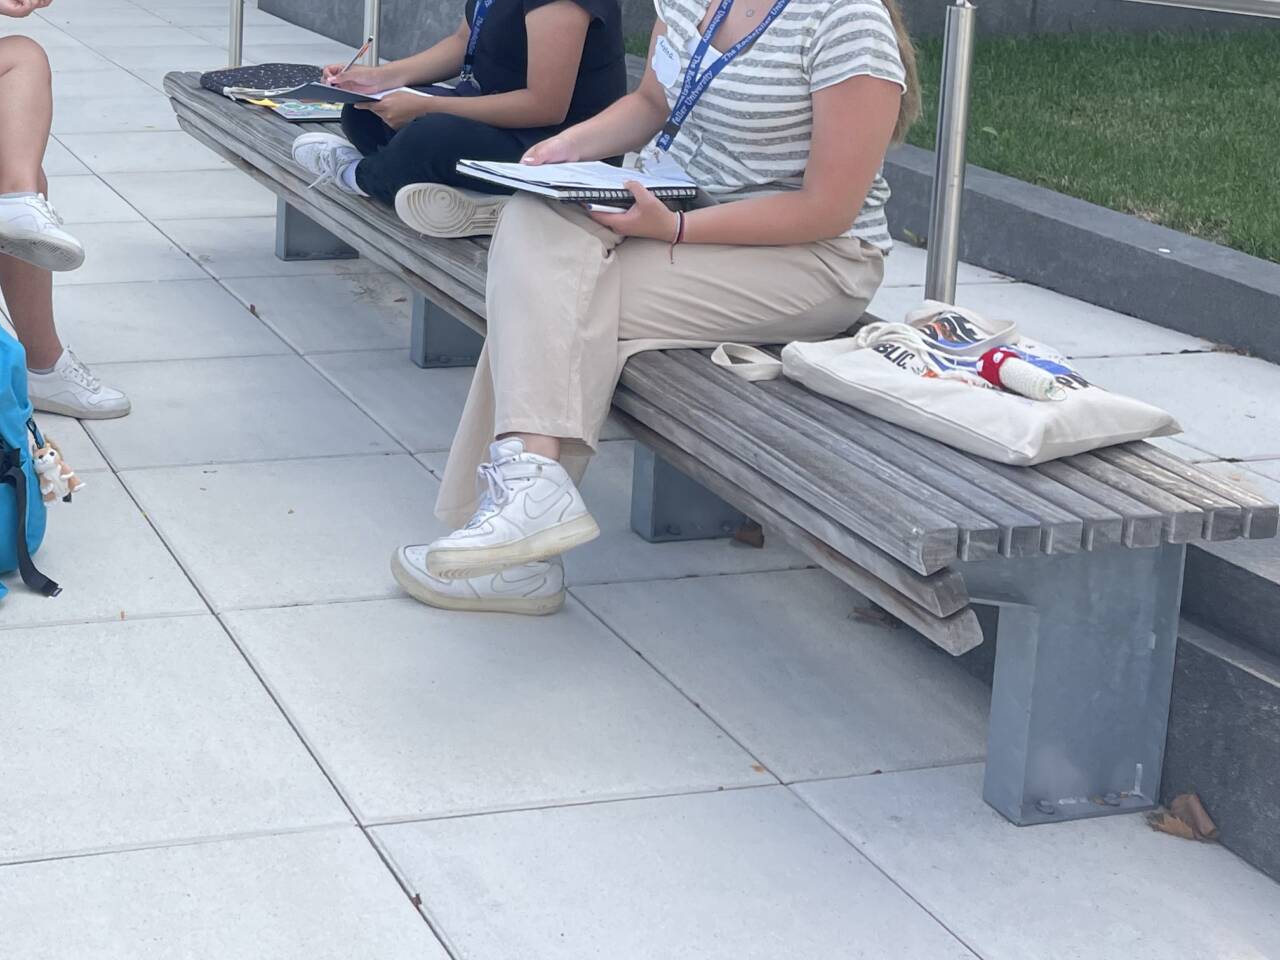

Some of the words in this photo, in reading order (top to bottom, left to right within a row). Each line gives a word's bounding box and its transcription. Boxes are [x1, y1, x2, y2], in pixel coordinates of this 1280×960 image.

[684, 70, 713, 106] University
[722, 49, 737, 62] The
[735, 14, 772, 52] Rockefeller
